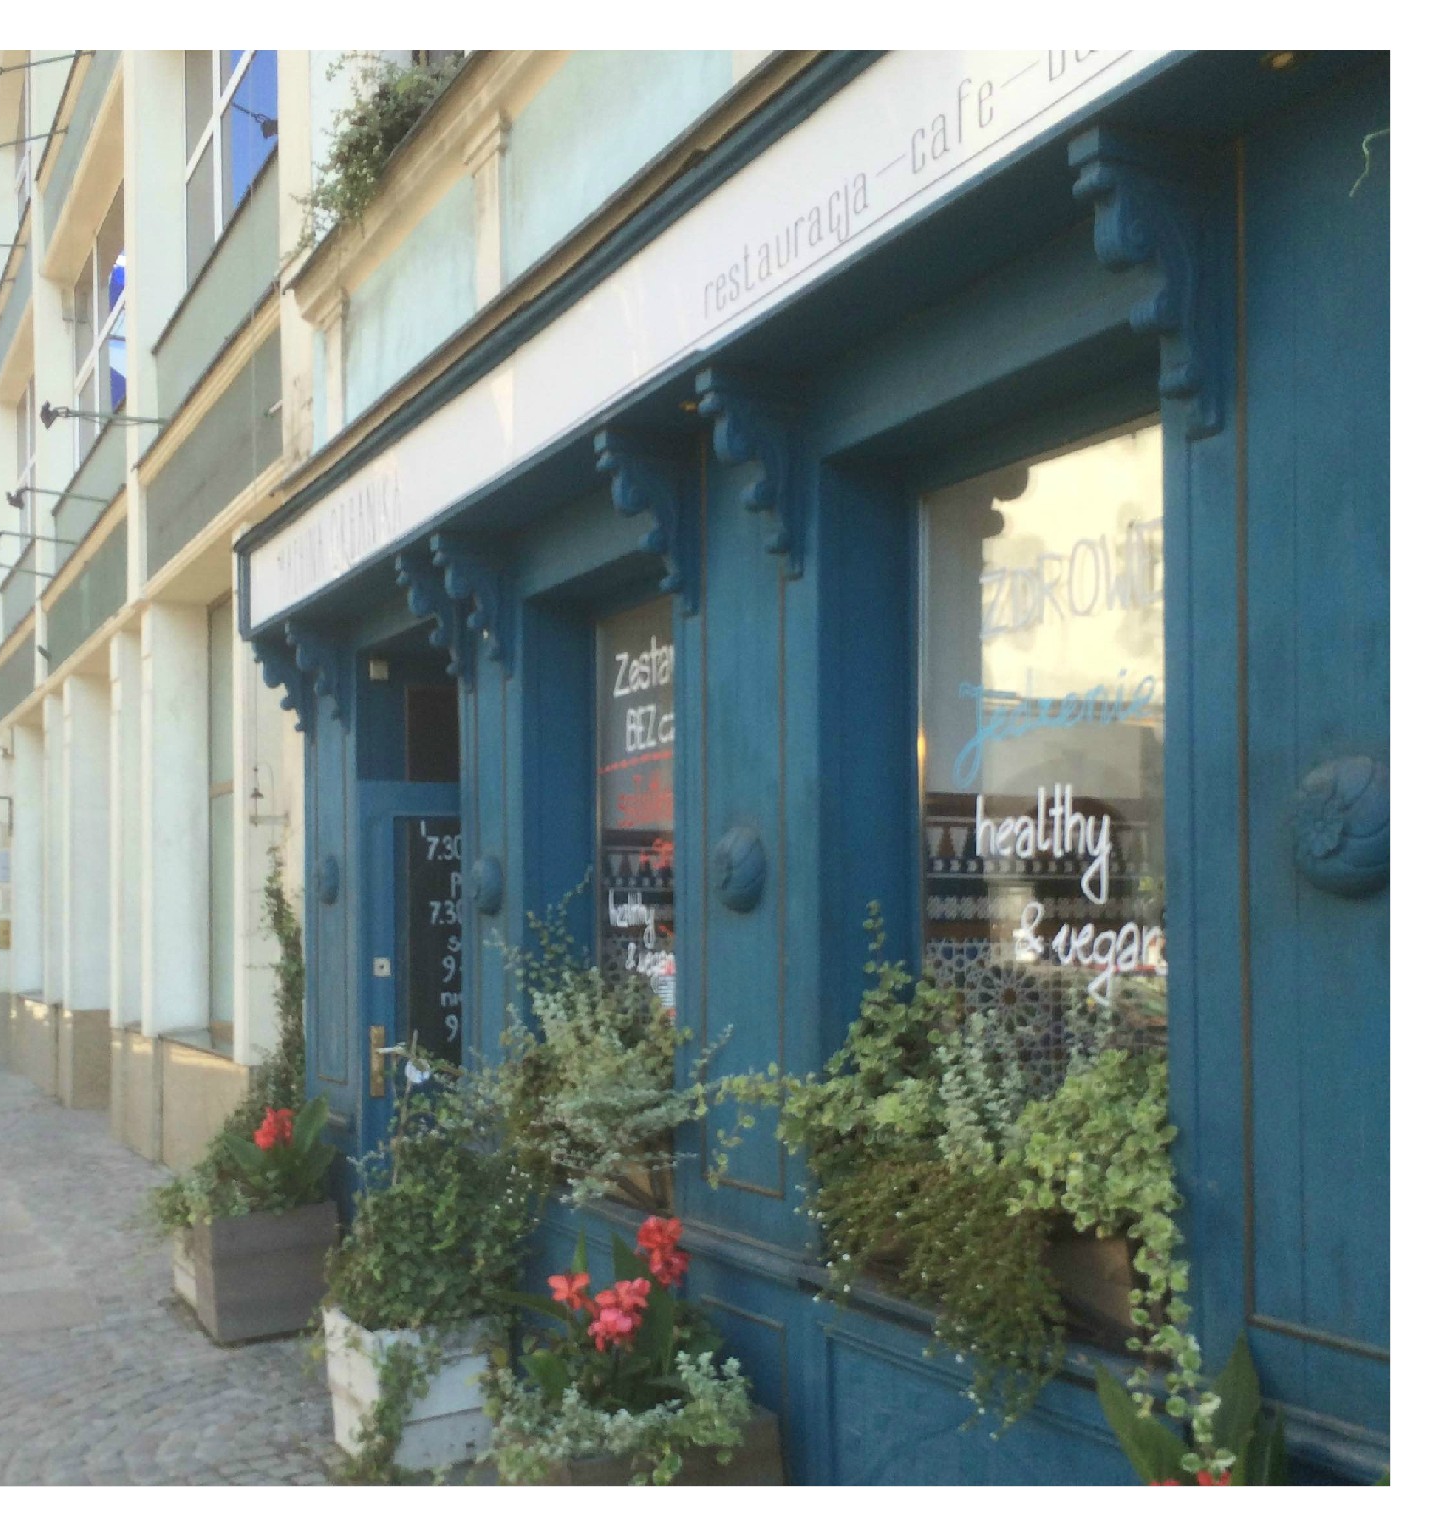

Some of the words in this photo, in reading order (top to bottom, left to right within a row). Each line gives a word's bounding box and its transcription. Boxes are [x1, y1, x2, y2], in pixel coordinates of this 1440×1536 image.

[703, 172, 869, 320] restauracja
[912, 78, 994, 174] cafe
[626, 703, 657, 752] BEZ
[975, 782, 1113, 905] healthy
[1015, 901, 1046, 957] &
